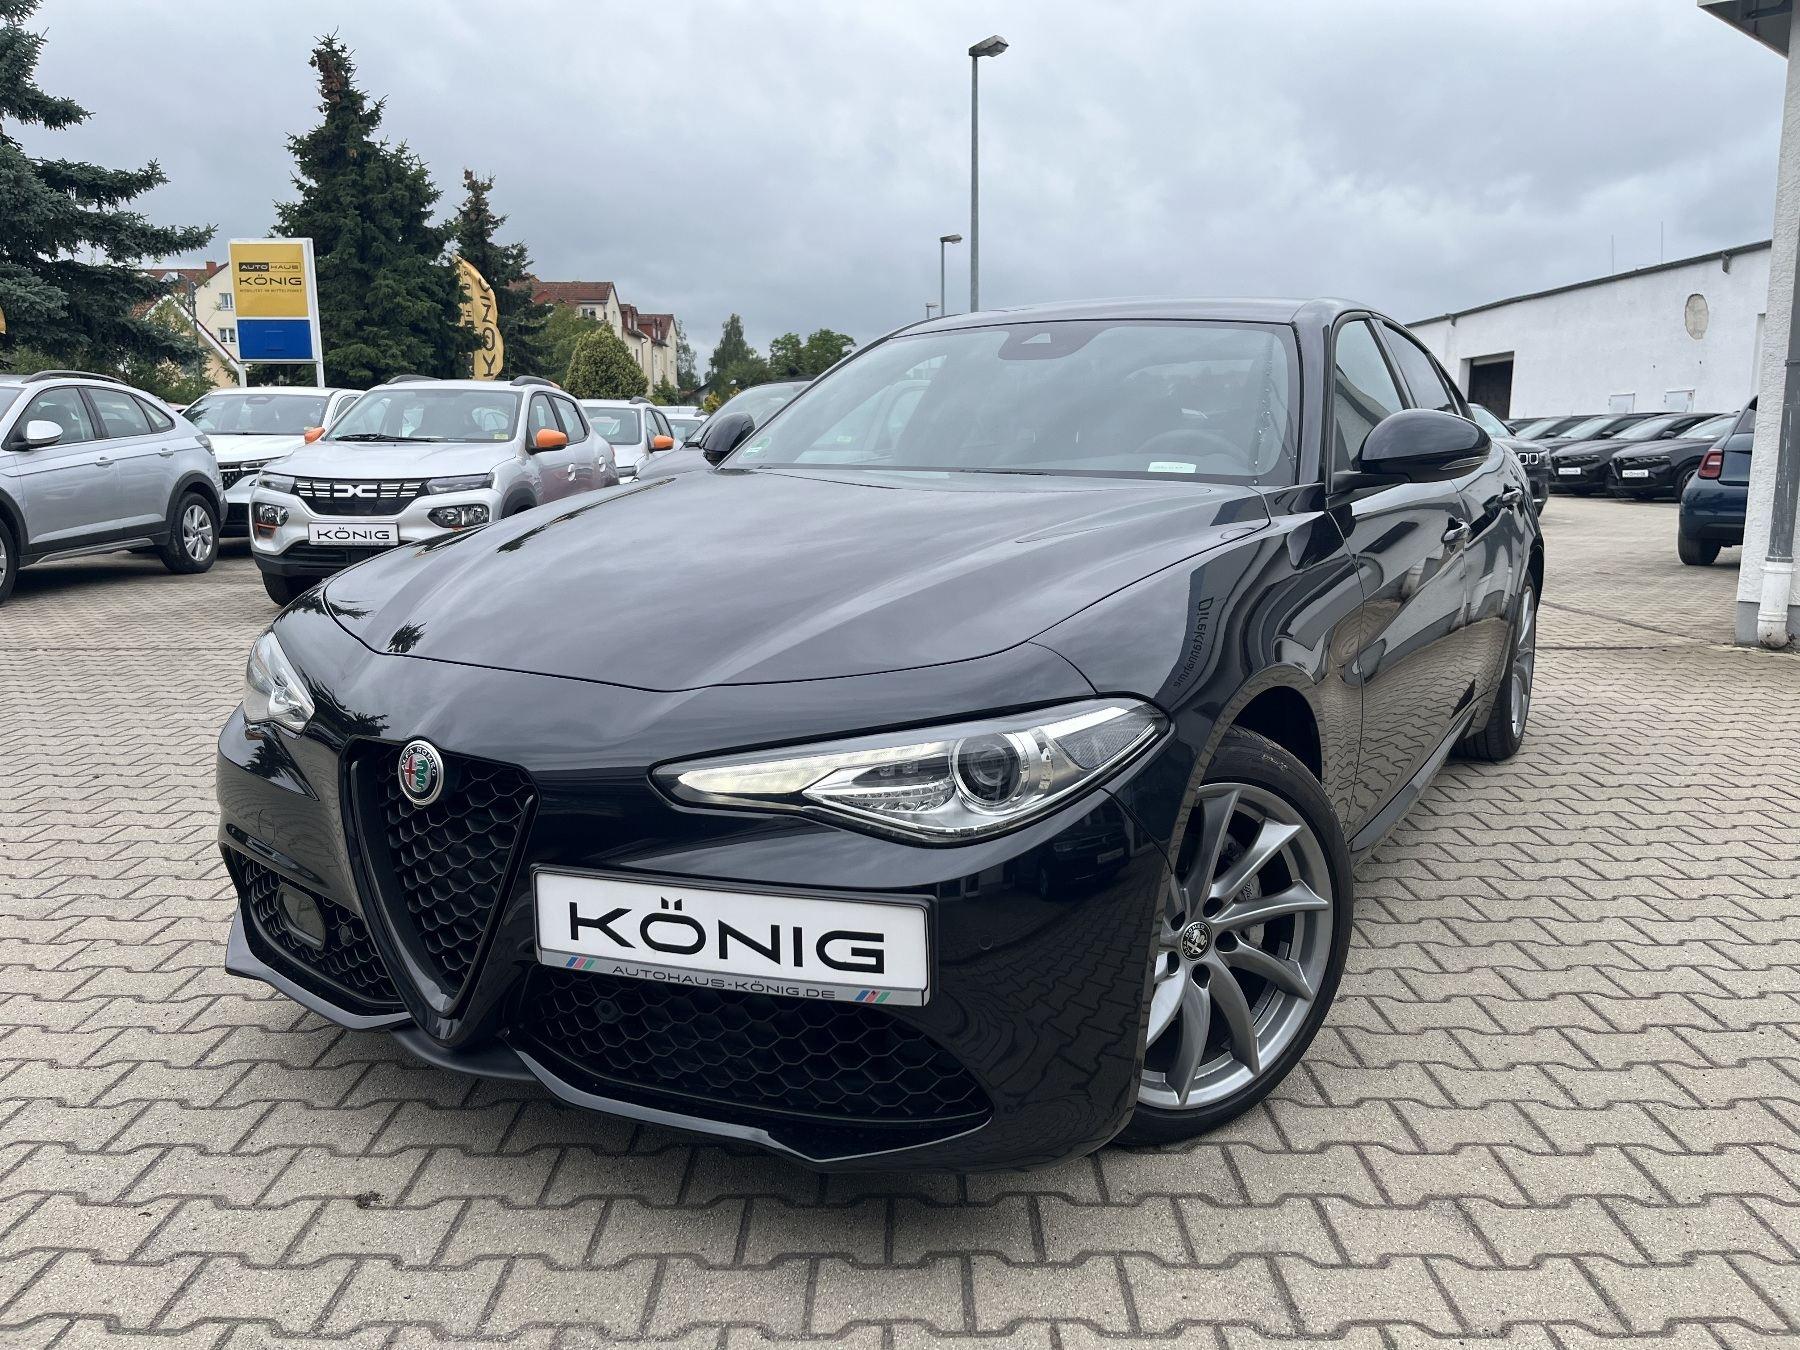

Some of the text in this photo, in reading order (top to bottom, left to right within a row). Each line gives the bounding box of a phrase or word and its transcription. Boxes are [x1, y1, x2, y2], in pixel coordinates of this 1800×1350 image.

[239, 274, 302, 286] KÖNIG
[317, 526, 390, 540] KÖNIG
[401, 746, 437, 776] ALFA ROMEO
[568, 896, 885, 975] KÖNIG
[612, 965, 836, 1000] AUTOHAUS-KÖNIG.DE
